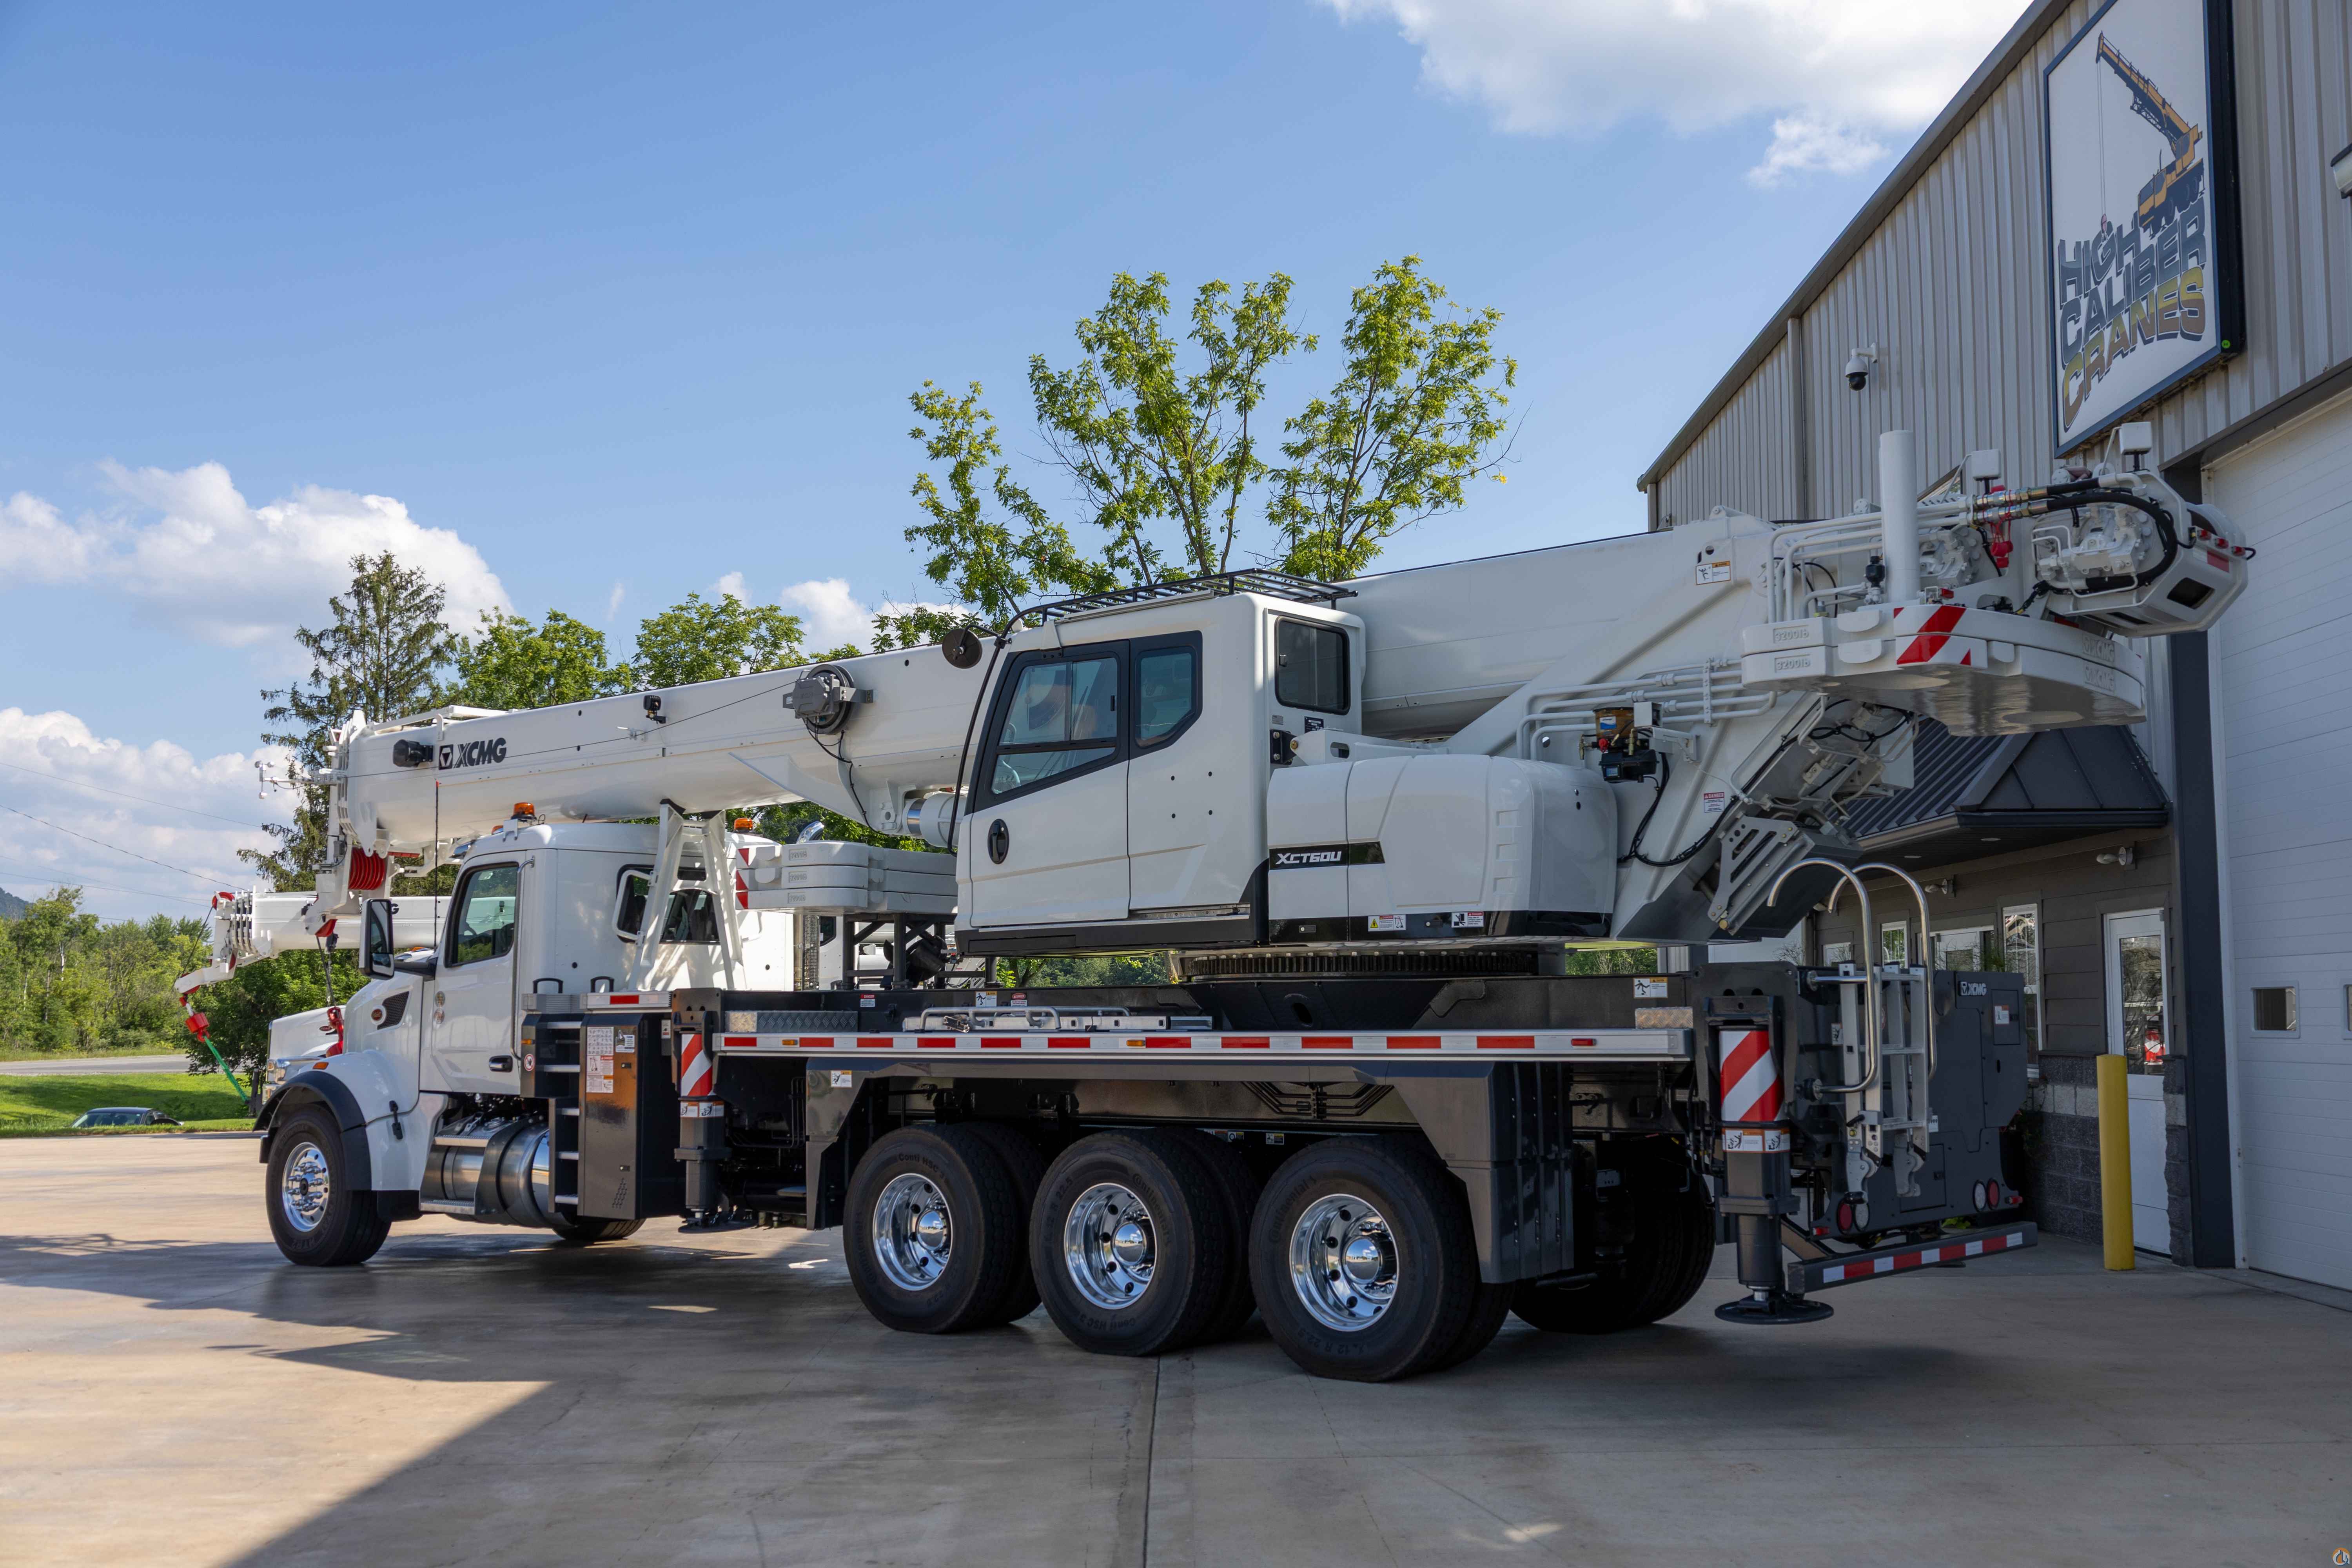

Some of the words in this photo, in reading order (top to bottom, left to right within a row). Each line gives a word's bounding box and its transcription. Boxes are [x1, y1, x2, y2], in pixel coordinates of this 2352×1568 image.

[2058, 210, 2141, 309] HIGH
[2060, 196, 2208, 370] CALIBER
[2063, 265, 2206, 433] CRANES
[454, 737, 507, 768] XCMG
[1275, 851, 1342, 865] XCT60U
[1968, 983, 1987, 996] XCMG
[898, 1153, 920, 1163] Conti
[1132, 1173, 1170, 1236] Continental
